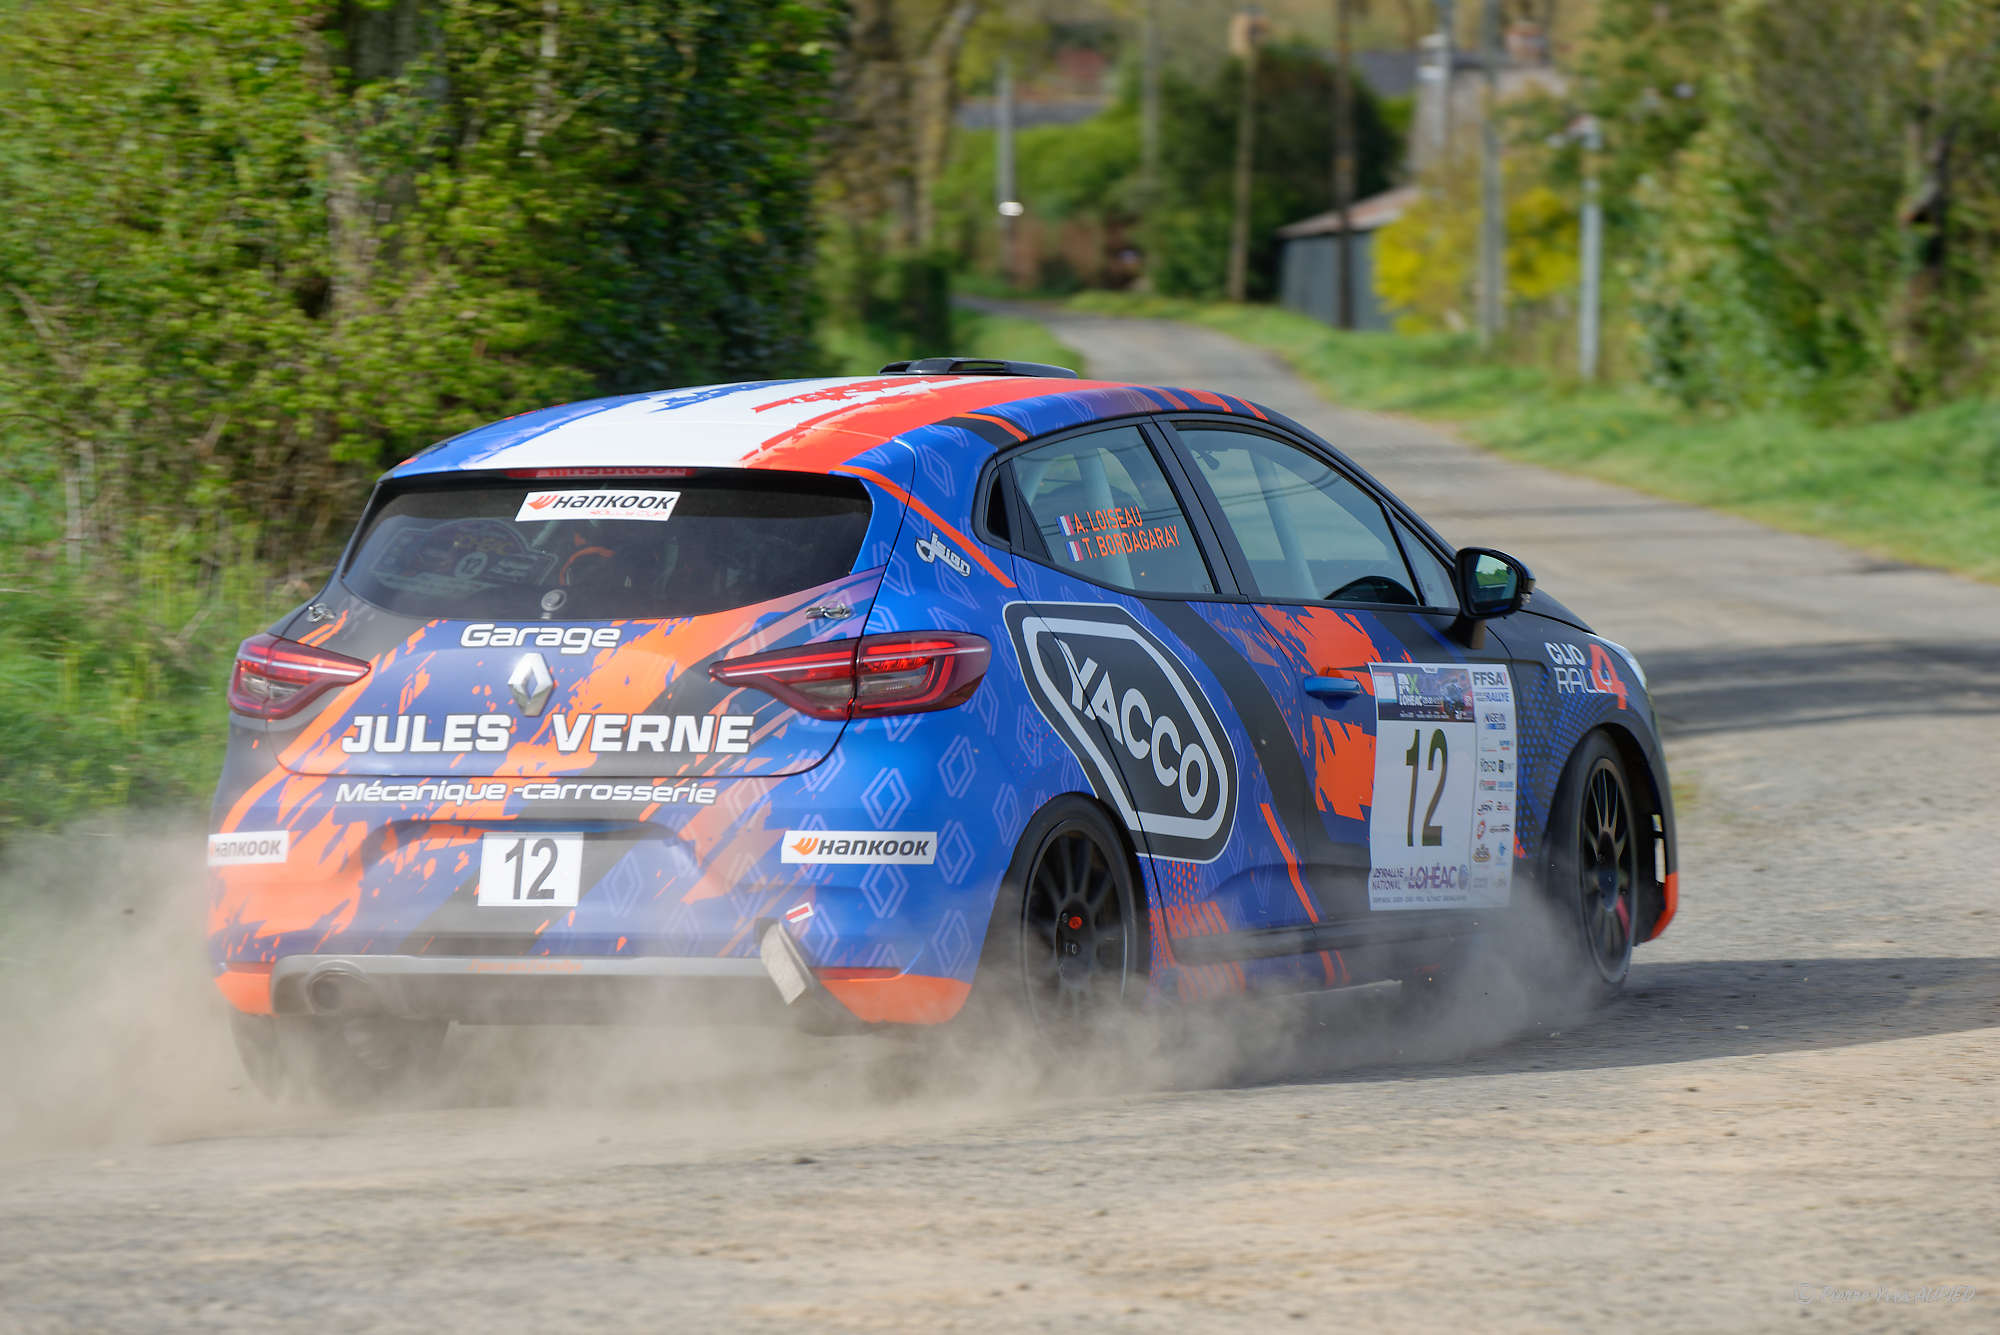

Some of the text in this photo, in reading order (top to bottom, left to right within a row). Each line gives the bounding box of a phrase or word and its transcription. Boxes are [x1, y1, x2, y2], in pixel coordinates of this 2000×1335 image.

[1075, 506, 1144, 534] A. LOISEAU
[1083, 526, 1181, 560] T. BORDAGARAY
[460, 622, 622, 655] Garage
[341, 714, 755, 753] JULES VERNE
[1055, 637, 1209, 815] YACCO
[335, 780, 506, 802] Mécanique
[1406, 729, 1448, 847] 12
[504, 838, 558, 900] 12
